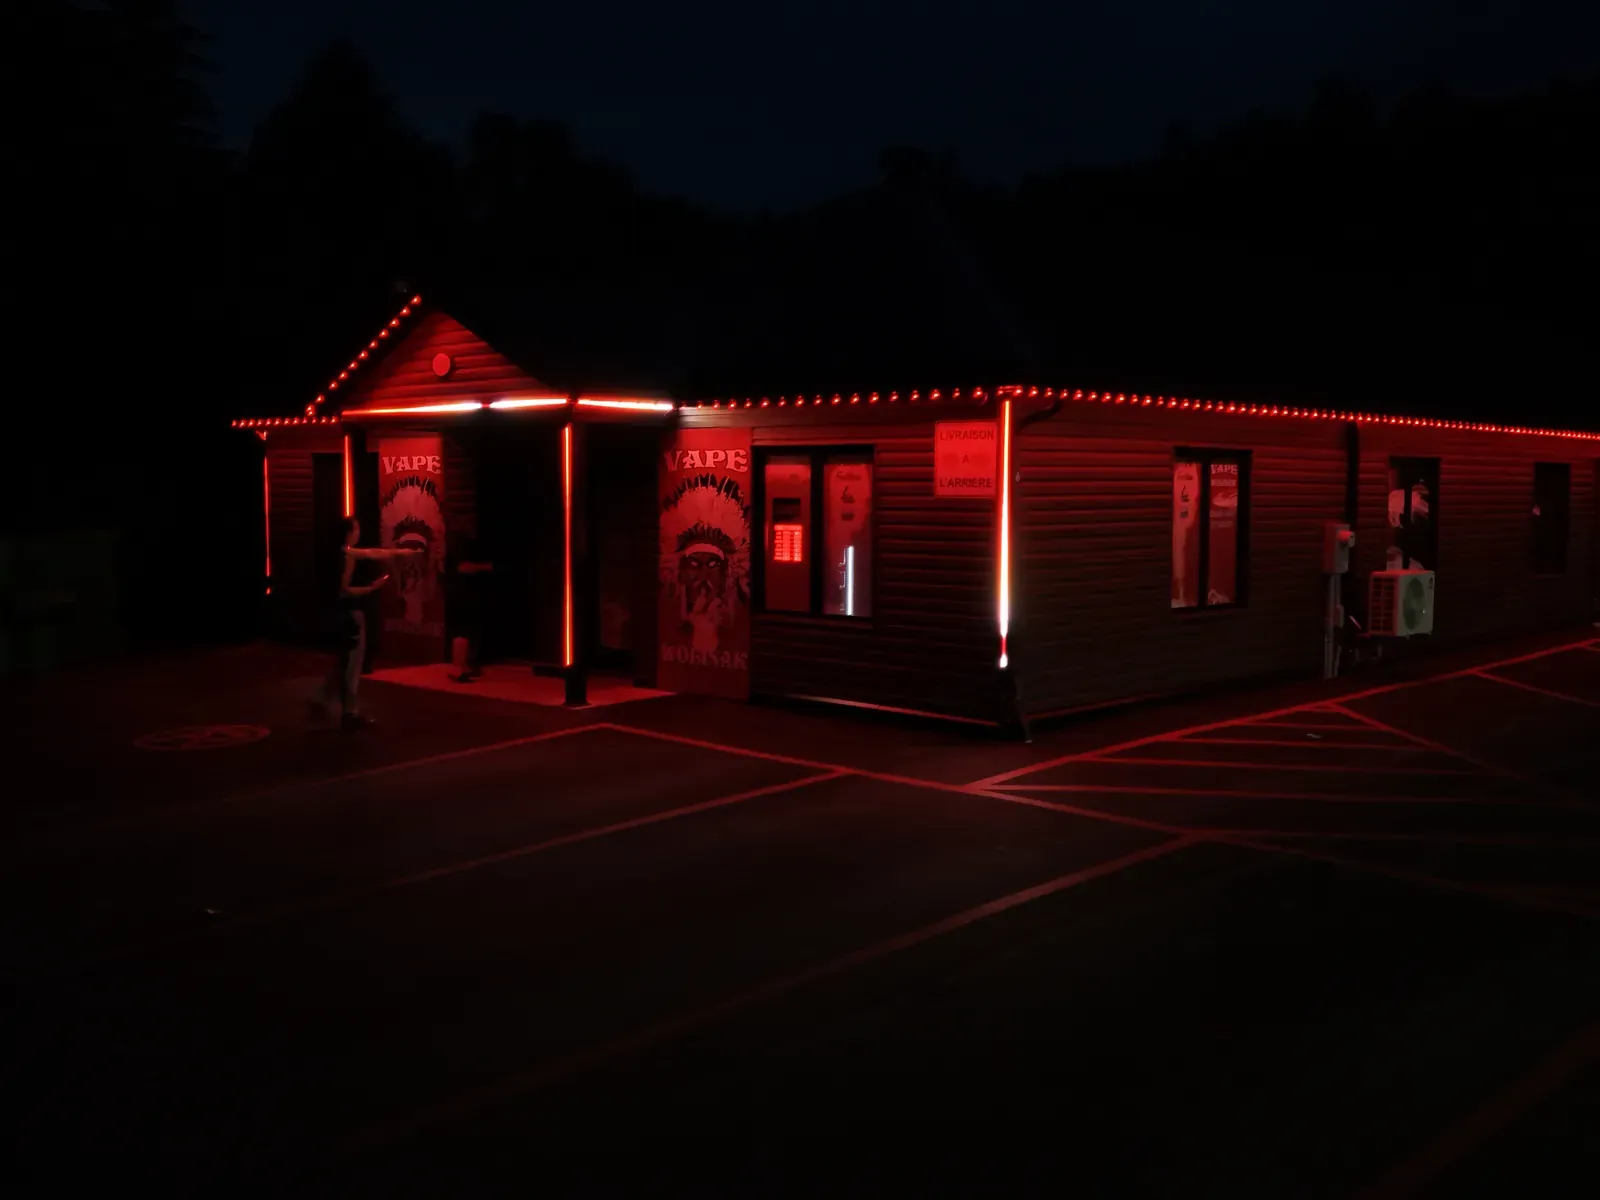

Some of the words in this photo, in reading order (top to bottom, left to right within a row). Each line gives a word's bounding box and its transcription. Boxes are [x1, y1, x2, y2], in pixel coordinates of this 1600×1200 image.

[940, 429, 994, 441] LIVRAISON
[382, 455, 441, 475] VAPE
[664, 449, 748, 473] VAPE
[1210, 464, 1238, 475] VAPE
